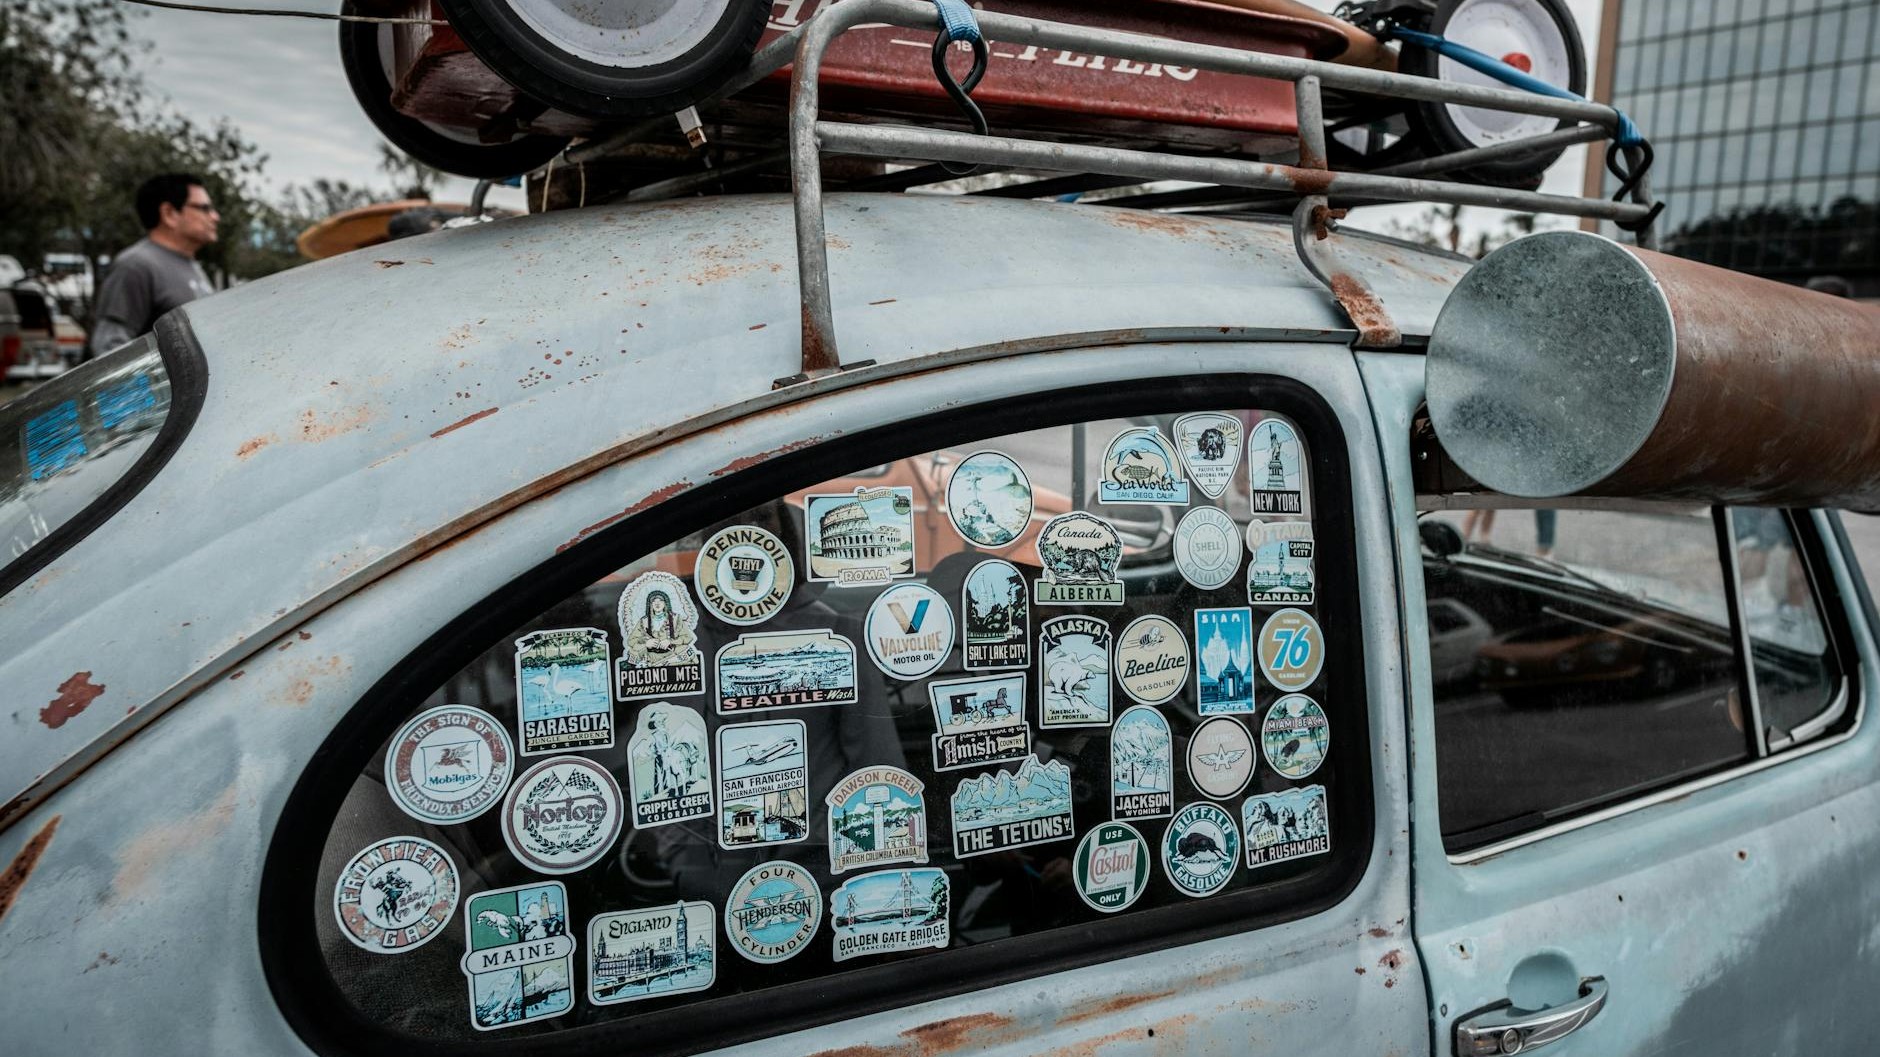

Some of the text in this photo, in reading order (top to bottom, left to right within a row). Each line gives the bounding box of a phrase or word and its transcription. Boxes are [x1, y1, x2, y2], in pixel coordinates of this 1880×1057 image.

[1254, 493, 1299, 512] NEW YORK
[1057, 526, 1103, 539] Canada
[1181, 510, 1214, 540] MOTOR
[1250, 522, 1313, 548] OTTAWA
[706, 530, 786, 567] PENNZOIL
[1195, 541, 1220, 552] SHELL
[1290, 542, 1311, 550] CAPITAL
[731, 558, 761, 571] ETHYL
[1184, 557, 1237, 583] GASOLINE
[844, 569, 886, 582] ROMA
[705, 584, 784, 618] GASOLINE
[1049, 588, 1112, 600] ALBERTA
[1254, 592, 1309, 601] CANADA
[1050, 620, 1101, 638] ALASKA
[1201, 613, 1240, 624] SIAM
[544, 632, 582, 640] FLAMINGO
[879, 631, 943, 658] VALVOLINE
[968, 643, 1026, 661] SALT LAKE CITY
[1269, 625, 1312, 671] 76
[893, 653, 936, 665] MOTOR OIL
[1124, 653, 1186, 679] Beeline
[621, 665, 700, 687] POCONO MTS.
[1136, 679, 1176, 692] GASOLINE
[626, 682, 697, 696] PENNSYLVANIA
[723, 690, 824, 710] SEATTLE
[409, 713, 492, 743] THE SIGN OF
[526, 712, 610, 738] SARASOTA
[1268, 716, 1324, 730] MIAMI BEACH
[527, 738, 609, 752] FLORIDA
[531, 731, 605, 745] JUNGLE GARDENS
[999, 738, 1022, 747] COUNTRY
[938, 735, 997, 767] Amish
[400, 762, 506, 815] FRIENDLY SERVICE
[429, 773, 477, 786] Mobilgas
[724, 769, 803, 792] SAN FRANCISCO
[726, 779, 803, 799] INTERNATIONAL AIRPORT
[834, 771, 919, 804] DAWSON CREEK
[518, 794, 607, 830] Norton
[638, 793, 710, 816] CRIPPLE CREEK
[1116, 793, 1170, 811] JACKSON
[1125, 807, 1160, 817] WYOMING
[647, 806, 702, 822] COLORADO
[1175, 807, 1232, 834] BUFFALO
[959, 827, 994, 852] THE
[999, 816, 1063, 845] TETONS
[1105, 829, 1123, 840] USE
[841, 847, 917, 865] BRITISH COLUMBIA CANADA
[1251, 848, 1267, 865] MT.
[1269, 837, 1326, 860] RUSHMORE
[341, 843, 441, 904] FRONTIER
[1089, 842, 1137, 885] Castrol
[749, 867, 796, 886] FOUR
[1174, 865, 1229, 889] GASOLINE
[1100, 892, 1122, 904] ONLY
[738, 898, 812, 930] HENDERSON
[382, 914, 438, 947] GAS
[741, 924, 812, 956] CYLINDER
[840, 923, 946, 951] GOLDEN GATE BRIDGE
[482, 942, 555, 968] MAINE
[840, 935, 947, 957] SAN FRANCISCO CALIFORNIA
